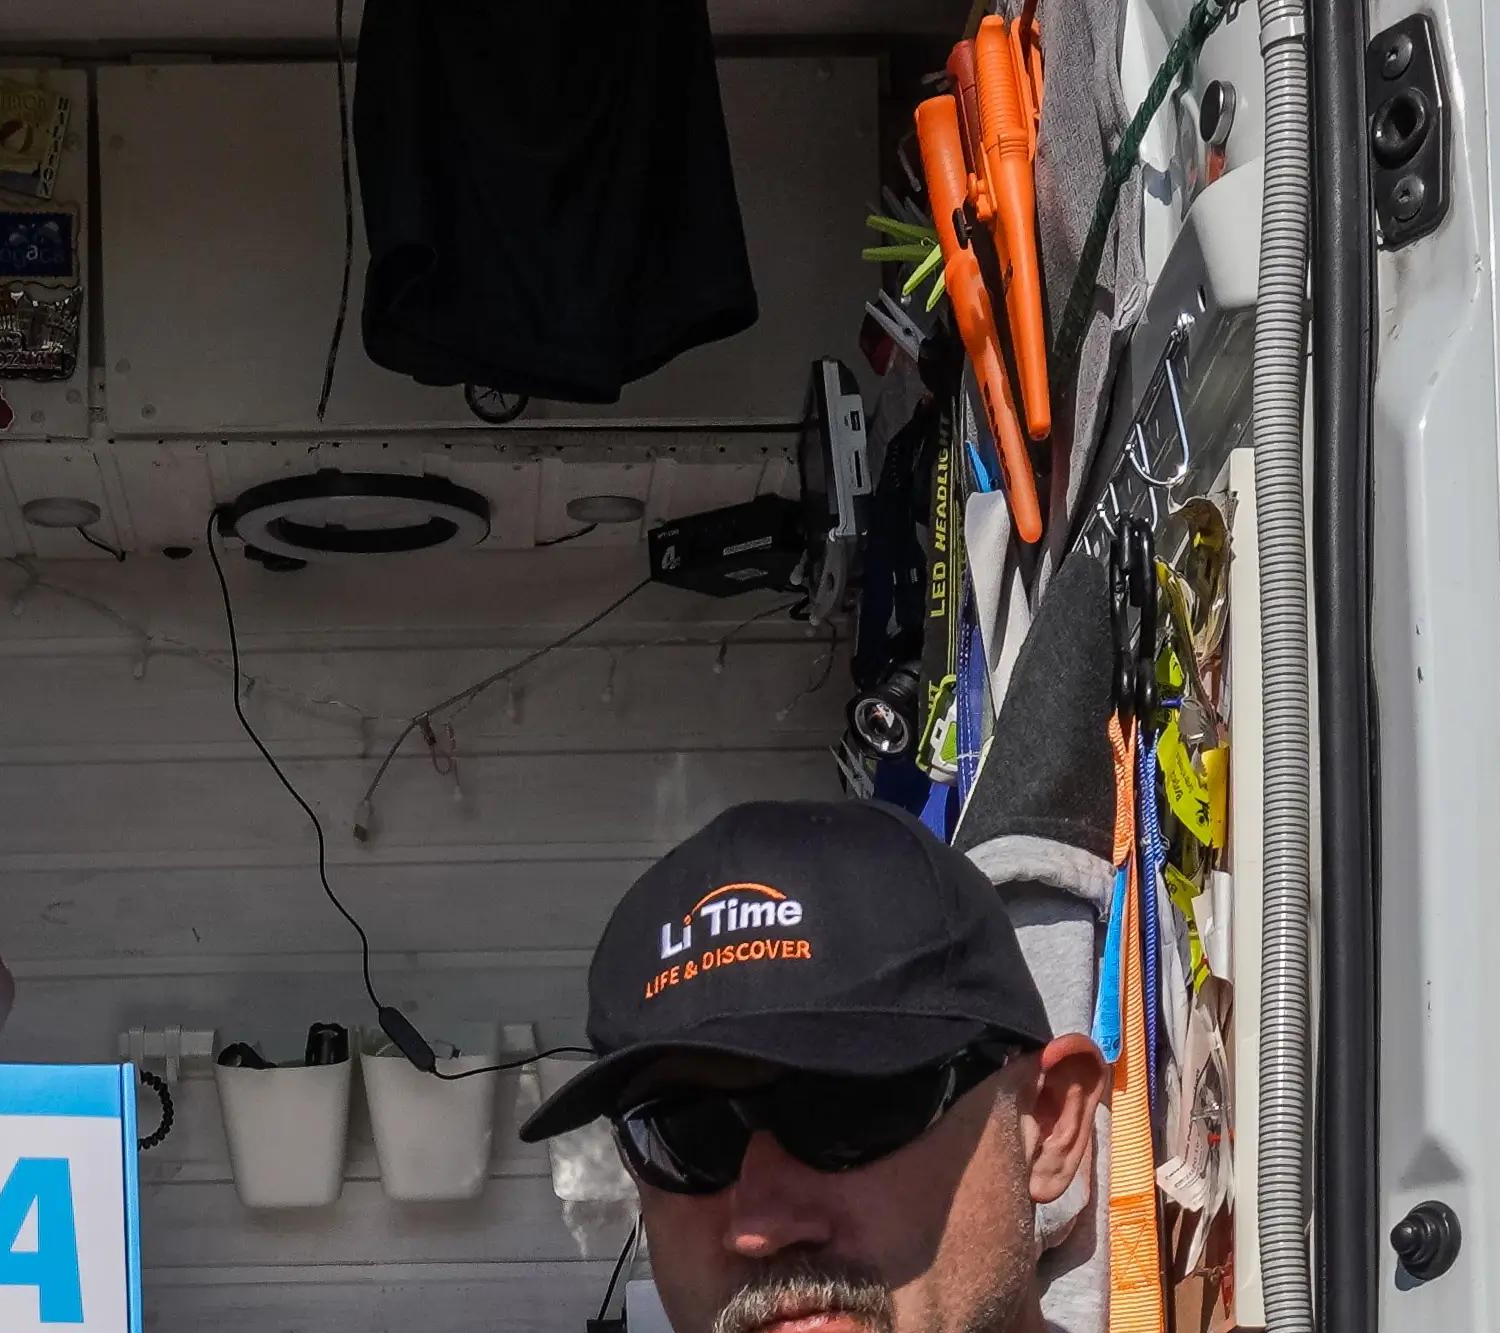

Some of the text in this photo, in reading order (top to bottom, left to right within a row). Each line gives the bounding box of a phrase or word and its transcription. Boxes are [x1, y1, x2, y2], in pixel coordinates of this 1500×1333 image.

[930, 413, 950, 618] LED HEADLIGHT
[660, 898, 802, 960] Li Time
[645, 939, 811, 999] LIFE & DISCOVER
